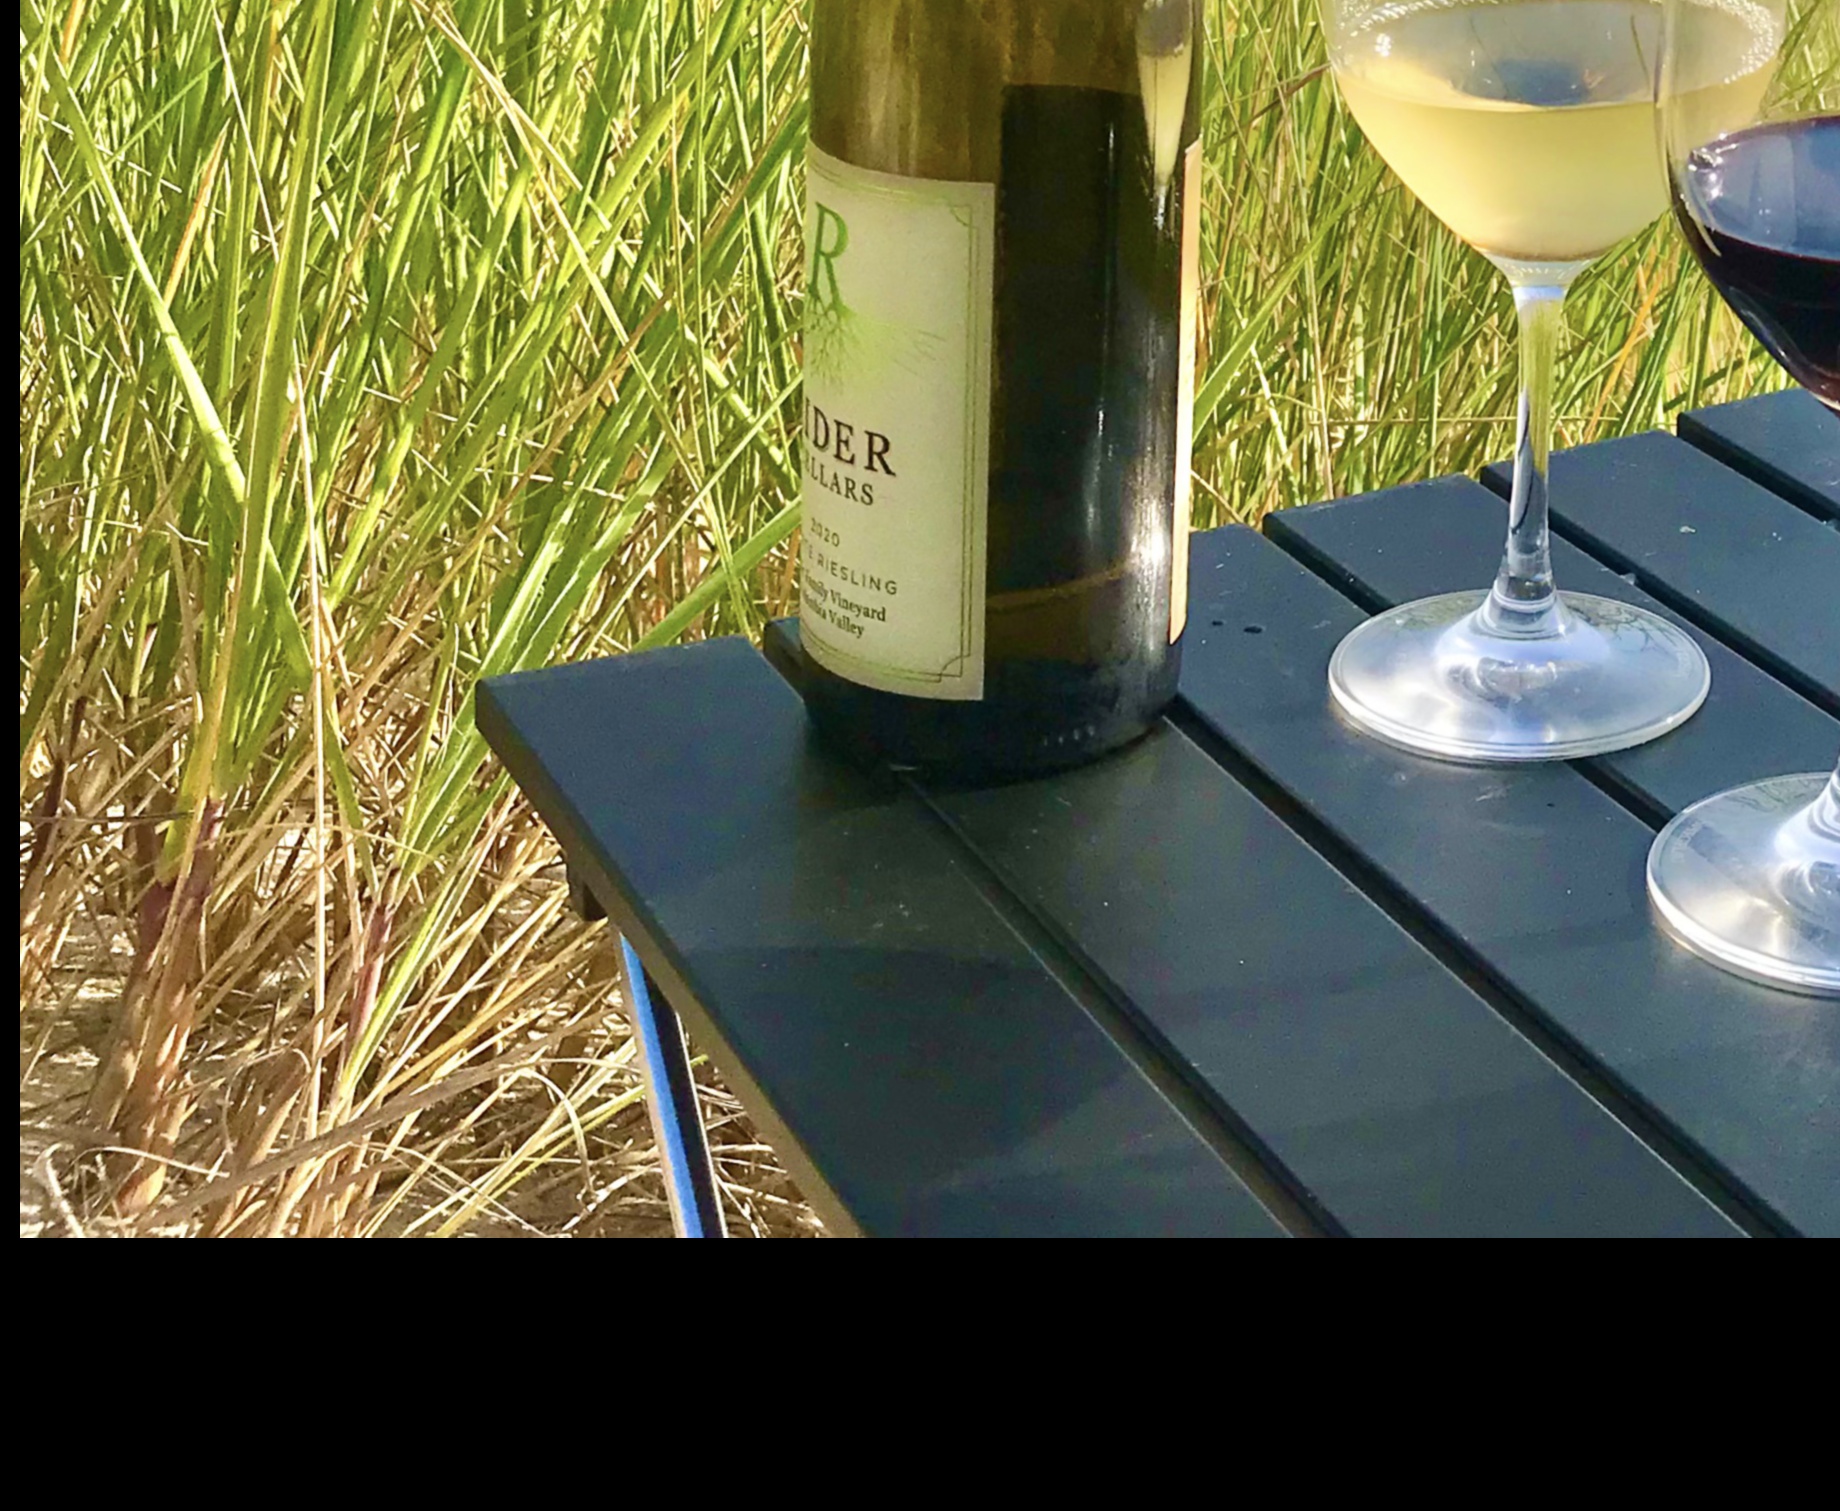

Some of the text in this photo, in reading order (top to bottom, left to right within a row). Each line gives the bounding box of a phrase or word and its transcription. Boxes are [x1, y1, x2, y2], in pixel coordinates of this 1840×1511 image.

[810, 517, 840, 548] 2020
[817, 553, 898, 596] RIESLING
[829, 588, 887, 623] Vineyard
[828, 609, 865, 639] Valley
